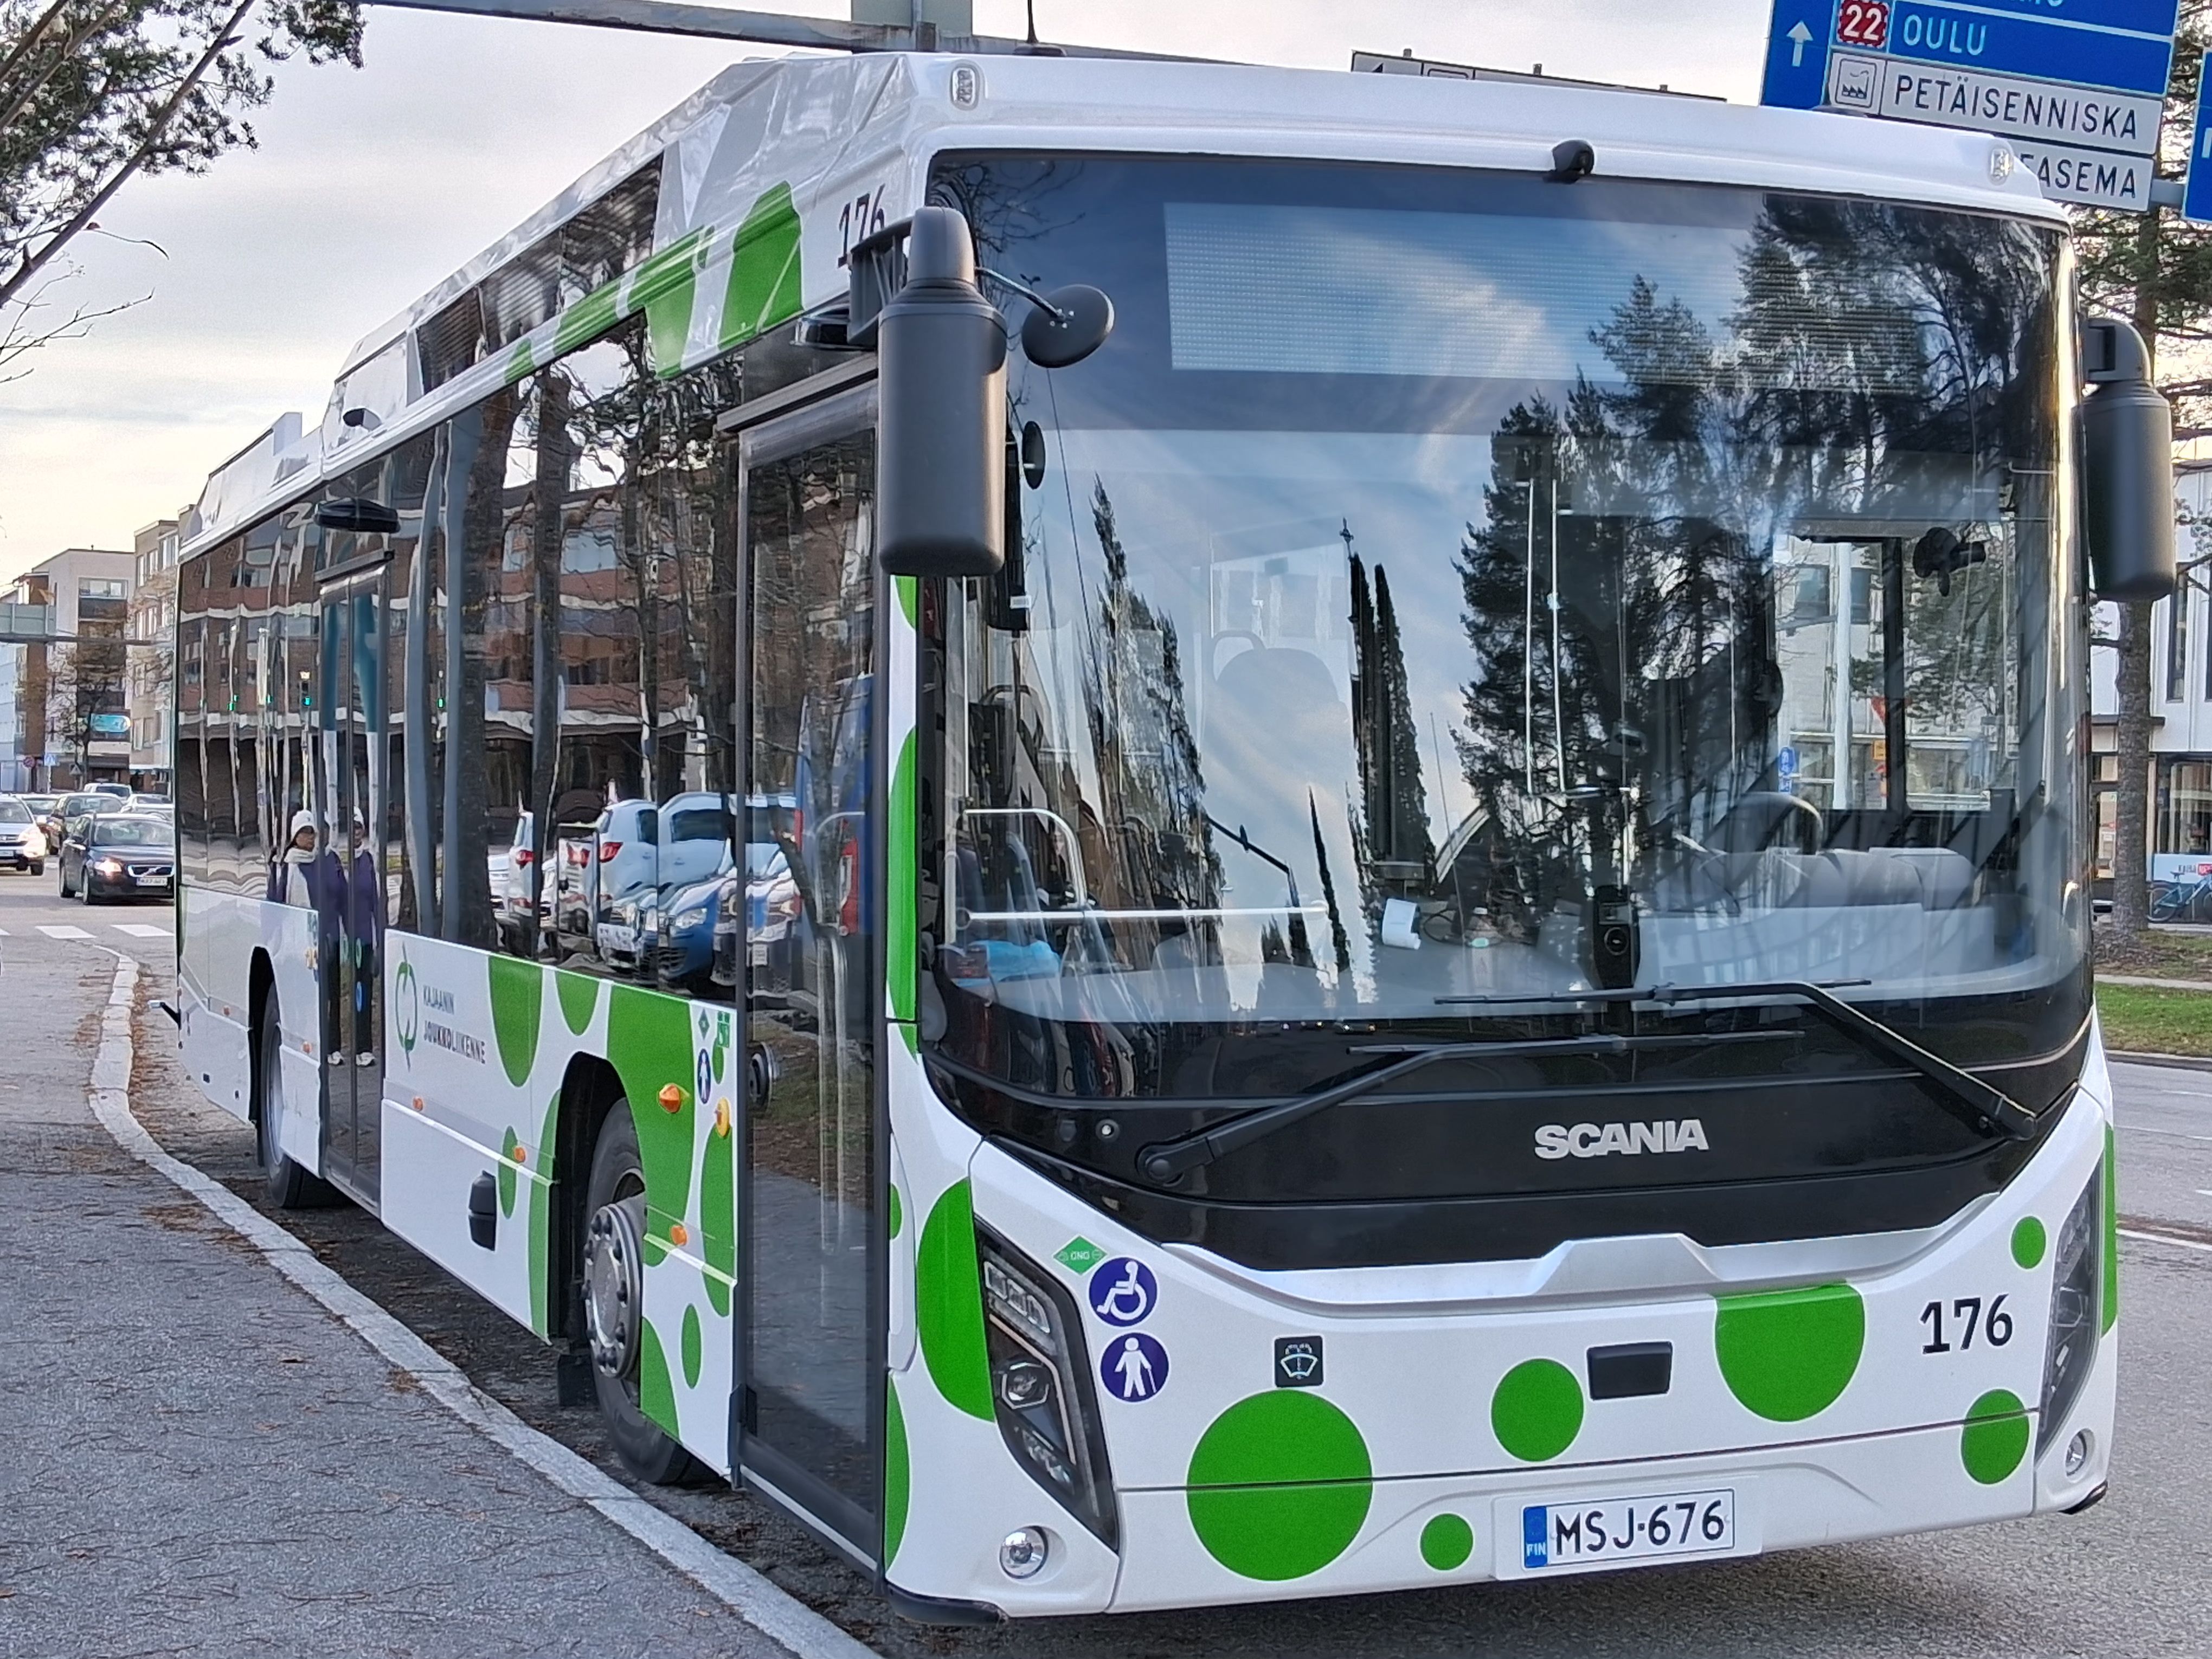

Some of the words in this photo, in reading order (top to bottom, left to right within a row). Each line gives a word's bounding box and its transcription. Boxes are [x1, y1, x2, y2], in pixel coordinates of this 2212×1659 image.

[1843, 4, 1882, 41] 22
[1904, 14, 1986, 55] OULU
[1894, 74, 2137, 140] PETÄISENNISKA
[838, 183, 886, 268] 176
[1534, 1118, 1709, 1159] SCANIA
[1920, 1293, 2012, 1354] 176
[1526, 1542, 1546, 1557] FIN
